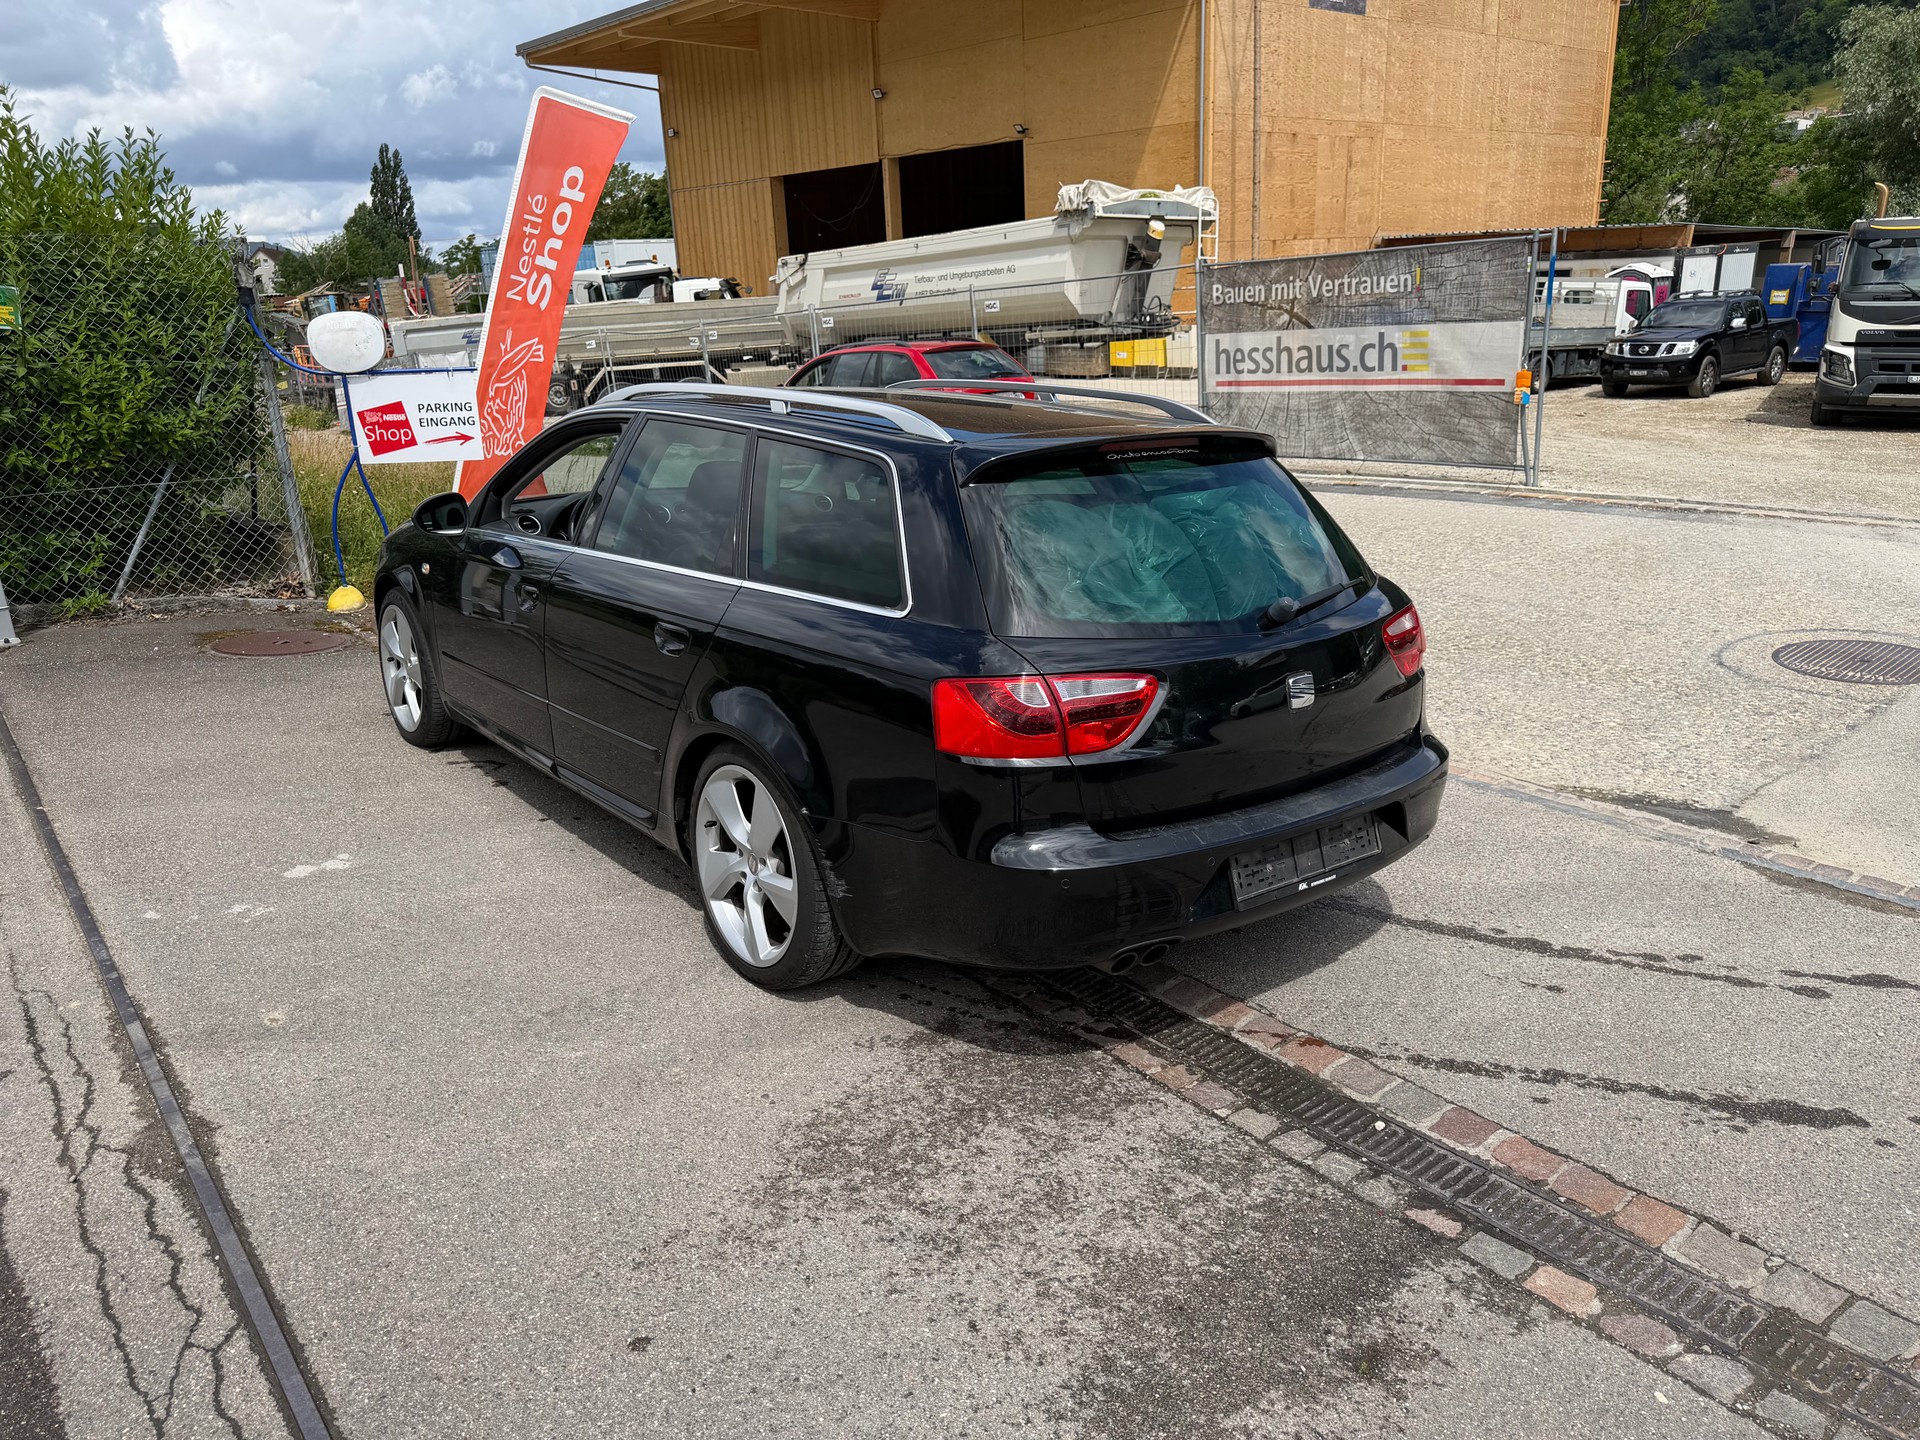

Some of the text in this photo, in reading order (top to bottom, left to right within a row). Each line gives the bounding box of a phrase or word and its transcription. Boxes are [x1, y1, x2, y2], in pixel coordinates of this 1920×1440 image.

[506, 193, 548, 302] Nestlé
[527, 165, 585, 312] Shop
[938, 273, 948, 281] und
[1006, 264, 1016, 274] AG
[1212, 283, 1265, 305] Bauen
[1271, 278, 1302, 301] mit
[1215, 331, 1398, 376] hesshaus.ch
[417, 401, 473, 413] PARKING
[419, 416, 476, 428] EINGANG
[364, 426, 412, 444] Shop
